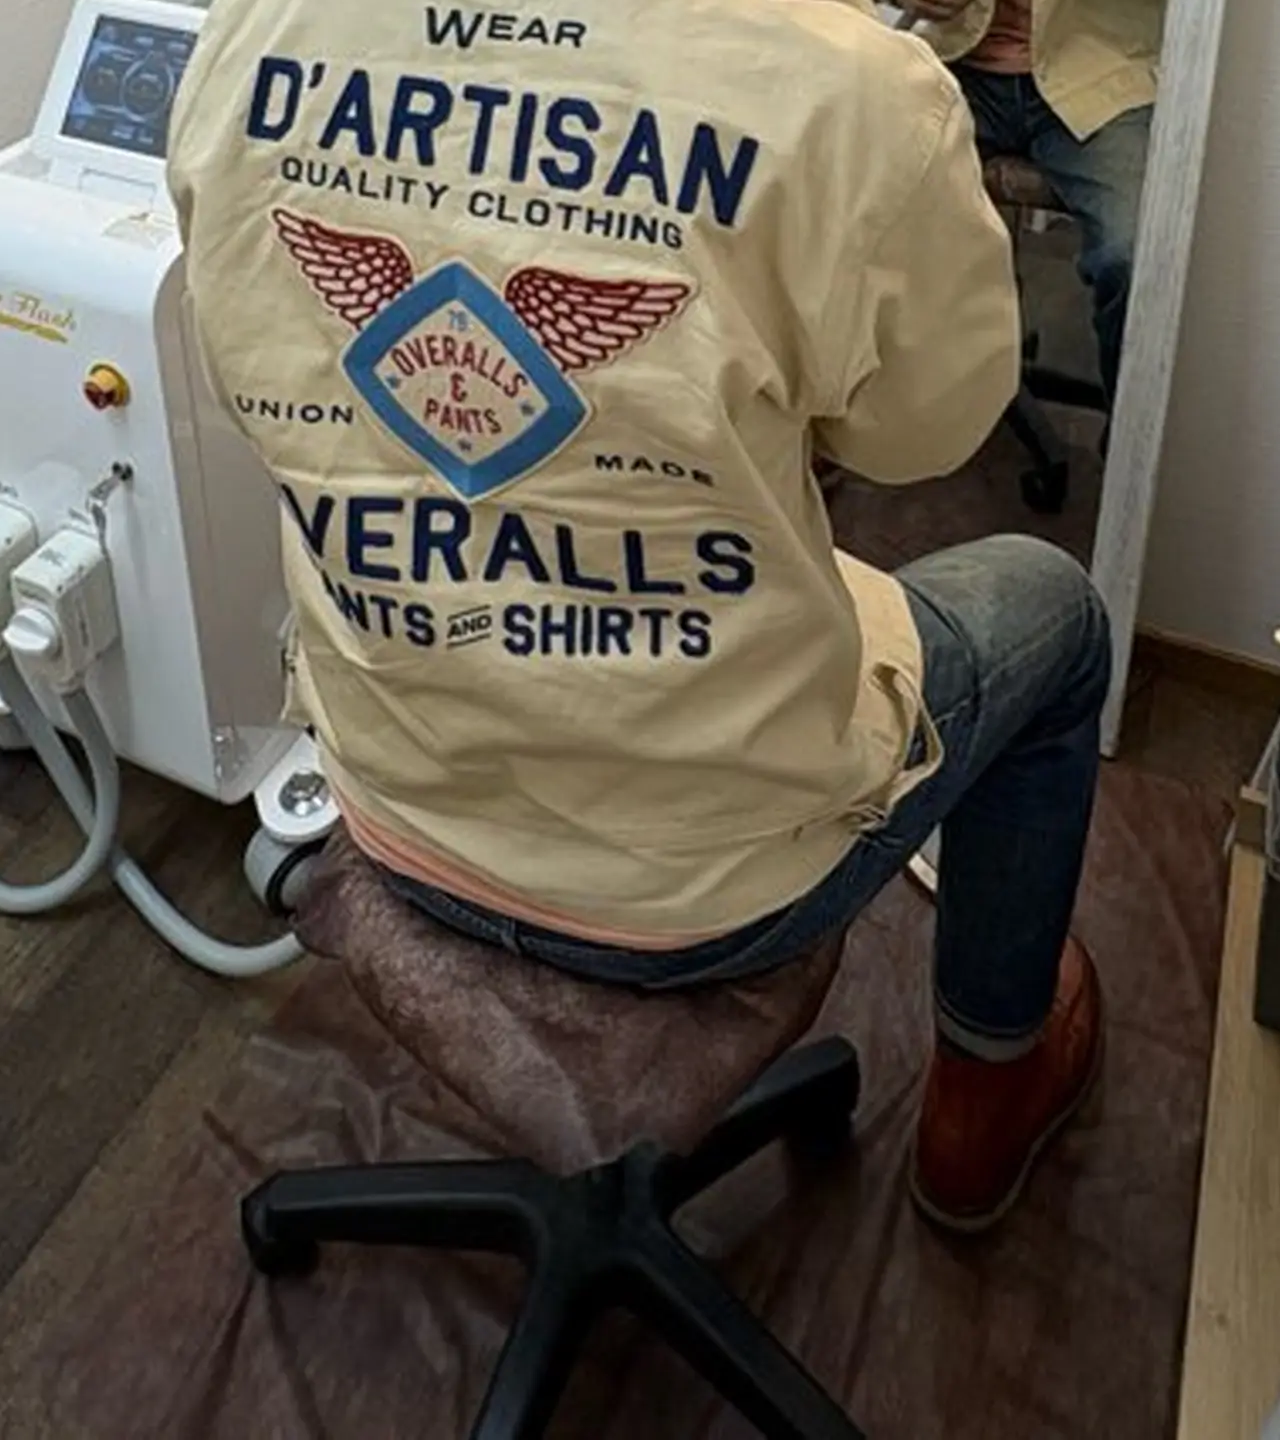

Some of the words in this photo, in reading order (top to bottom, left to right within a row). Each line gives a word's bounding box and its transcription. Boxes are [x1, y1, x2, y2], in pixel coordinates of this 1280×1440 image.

[424, 6, 587, 49] WEAR
[246, 56, 759, 227] D'ARTISAN
[280, 156, 450, 210] QUALITY
[468, 190, 685, 251] CLOTHING
[391, 334, 528, 399] OVERALLS
[235, 394, 355, 425] UNION
[424, 398, 503, 435] PANTS
[595, 454, 716, 488] MADE
[281, 482, 757, 598] VERALLS
[446, 615, 492, 640] AND
[503, 604, 713, 657] SHIRTS
